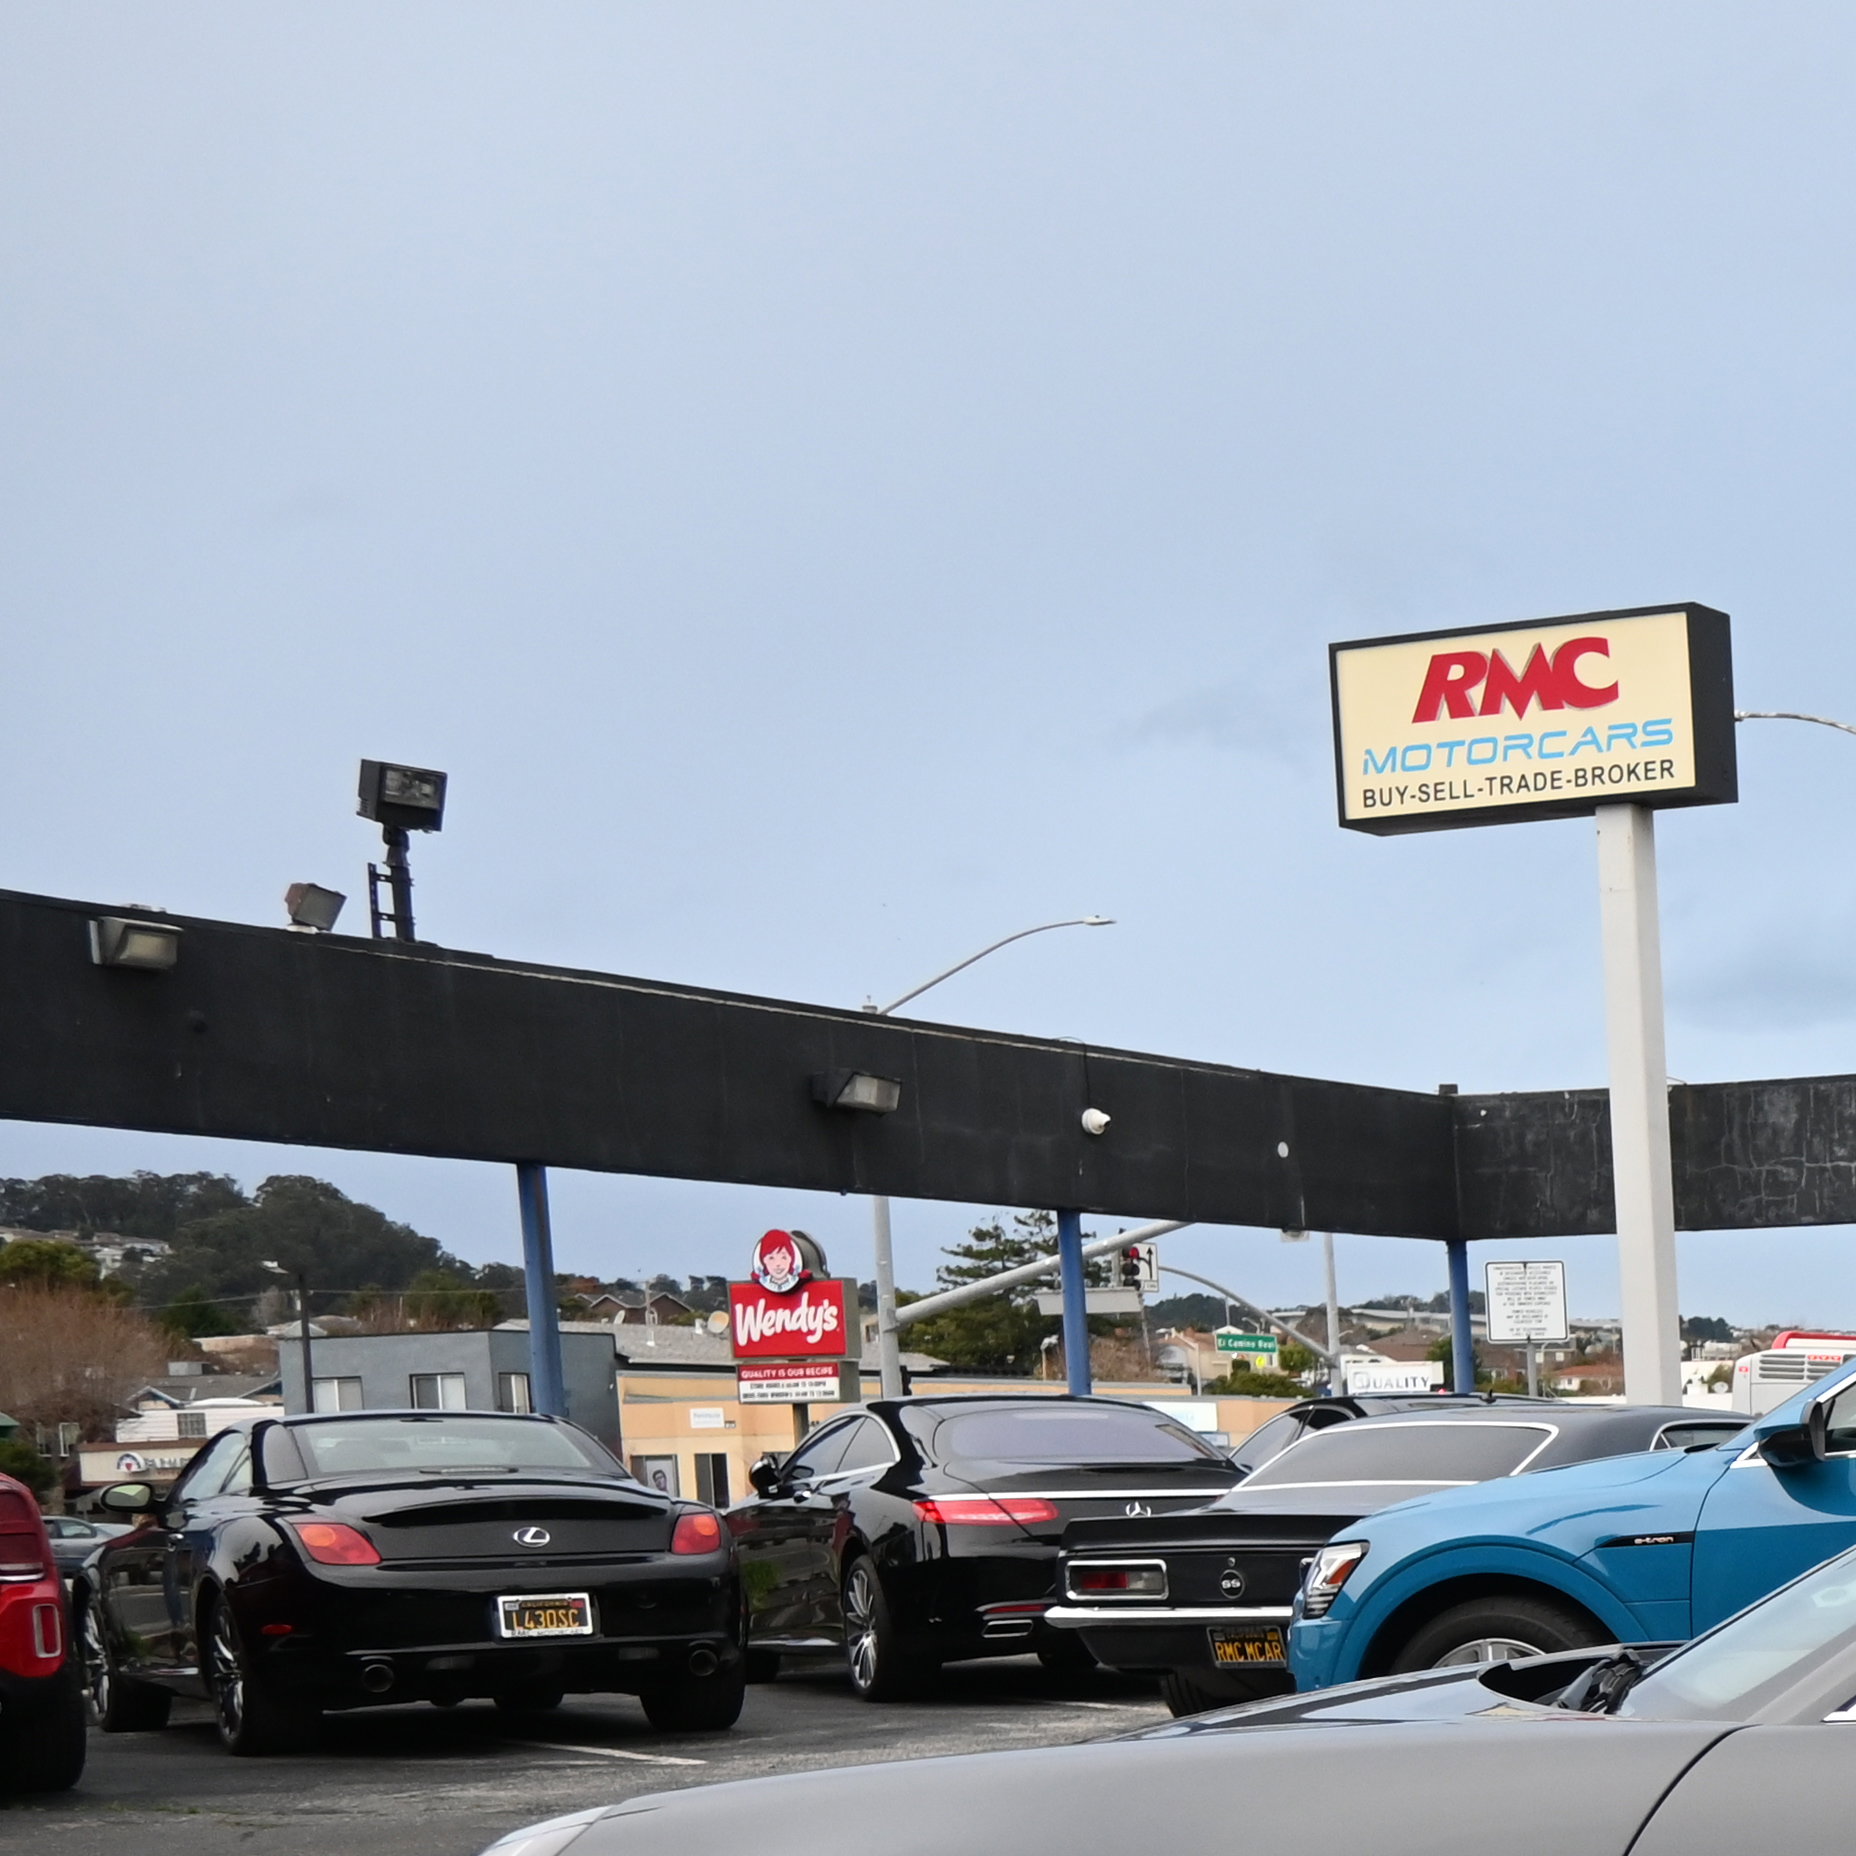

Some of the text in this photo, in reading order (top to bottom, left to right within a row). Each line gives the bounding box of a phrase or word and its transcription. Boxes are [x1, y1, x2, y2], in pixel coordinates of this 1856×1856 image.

[1411, 636, 1619, 724] RMC
[1362, 717, 1673, 776] MOTORCARS
[1362, 759, 1675, 809] BUY-SELL-TRADE-BROKER
[735, 1291, 838, 1346] Wendy's
[1228, 1338, 1255, 1348] Camino
[741, 1366, 833, 1379] QUALITY IS OUR RECIPE
[1353, 1371, 1430, 1390] QUALITY
[1634, 1536, 1674, 1544] e-tron
[1222, 1579, 1240, 1589] SS
[1215, 1641, 1285, 1662] RMC MCAR
